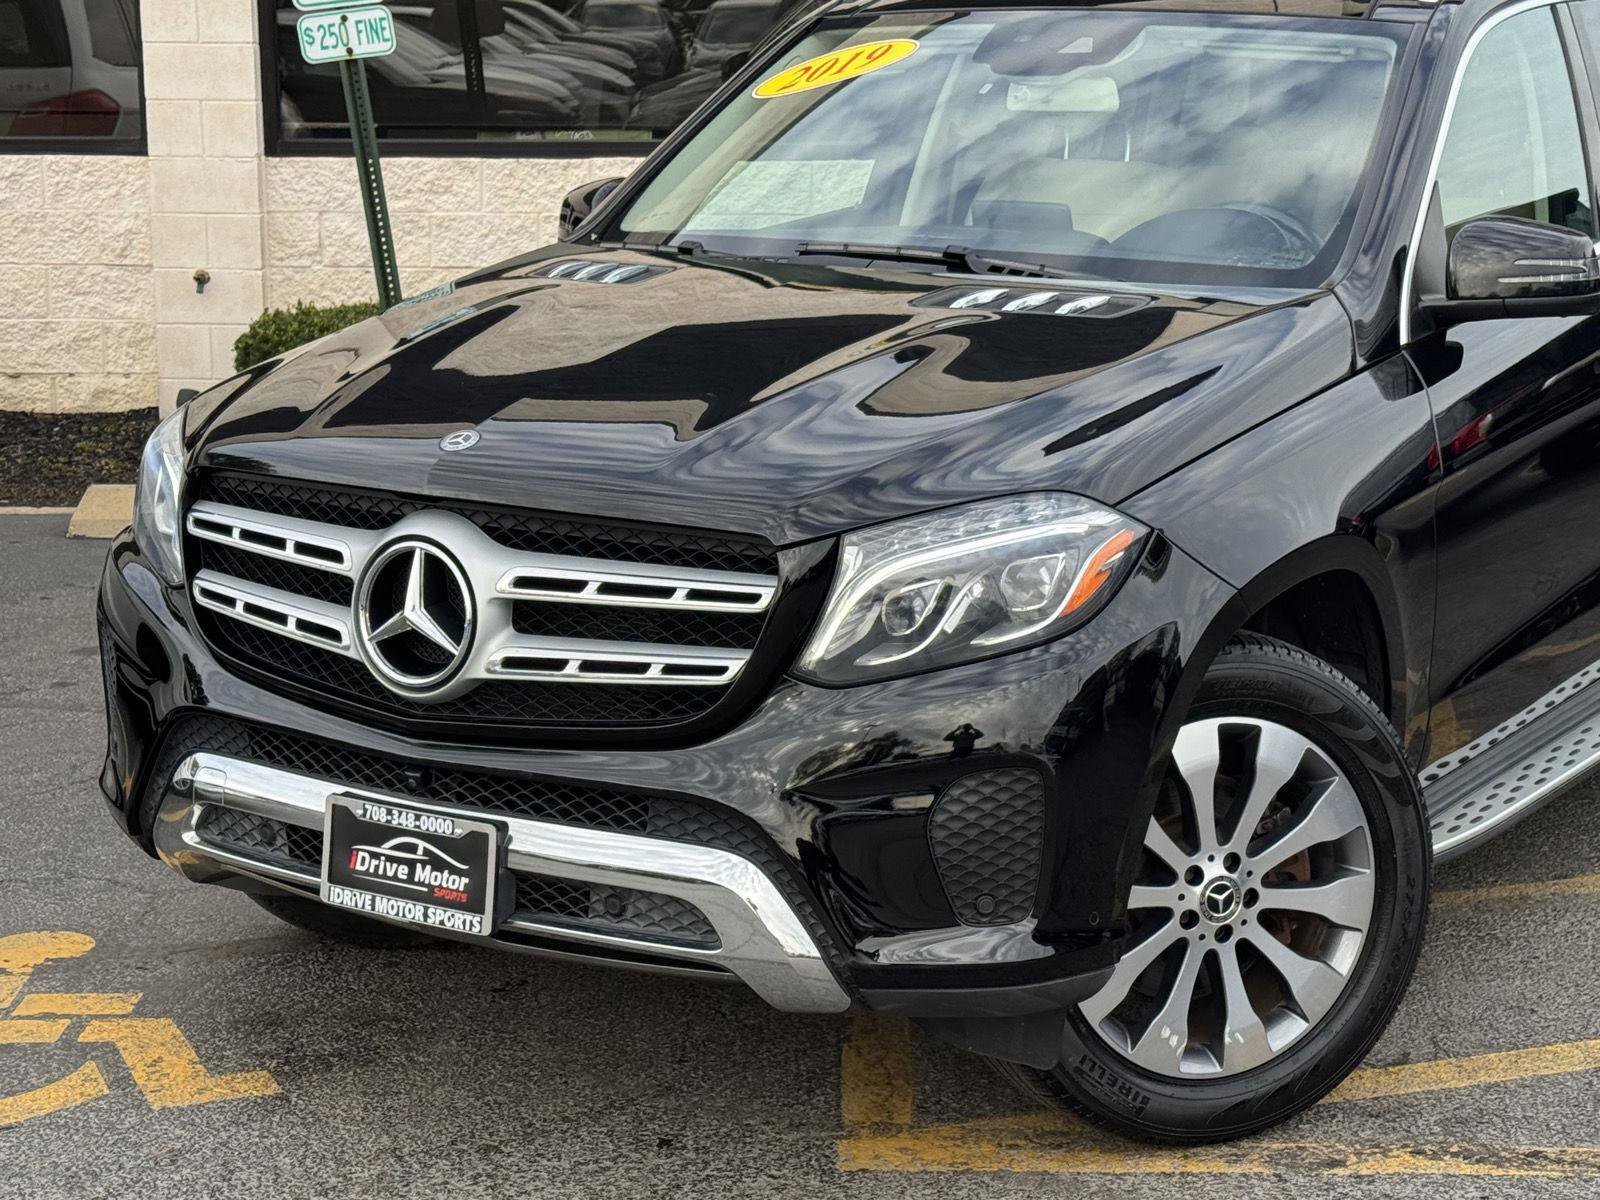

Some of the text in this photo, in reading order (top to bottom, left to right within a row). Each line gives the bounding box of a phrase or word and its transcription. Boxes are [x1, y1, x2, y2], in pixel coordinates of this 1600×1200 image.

[355, 17, 390, 45] FINE
[776, 44, 893, 91] 2019
[364, 804, 453, 834] 708-348-0000
[350, 850, 469, 891] iDrive Motor
[433, 887, 468, 902] SPORTS
[375, 896, 425, 922] MOTOR
[427, 907, 481, 933] SPORTS
[1077, 1053, 1152, 1118] PIRELLI
